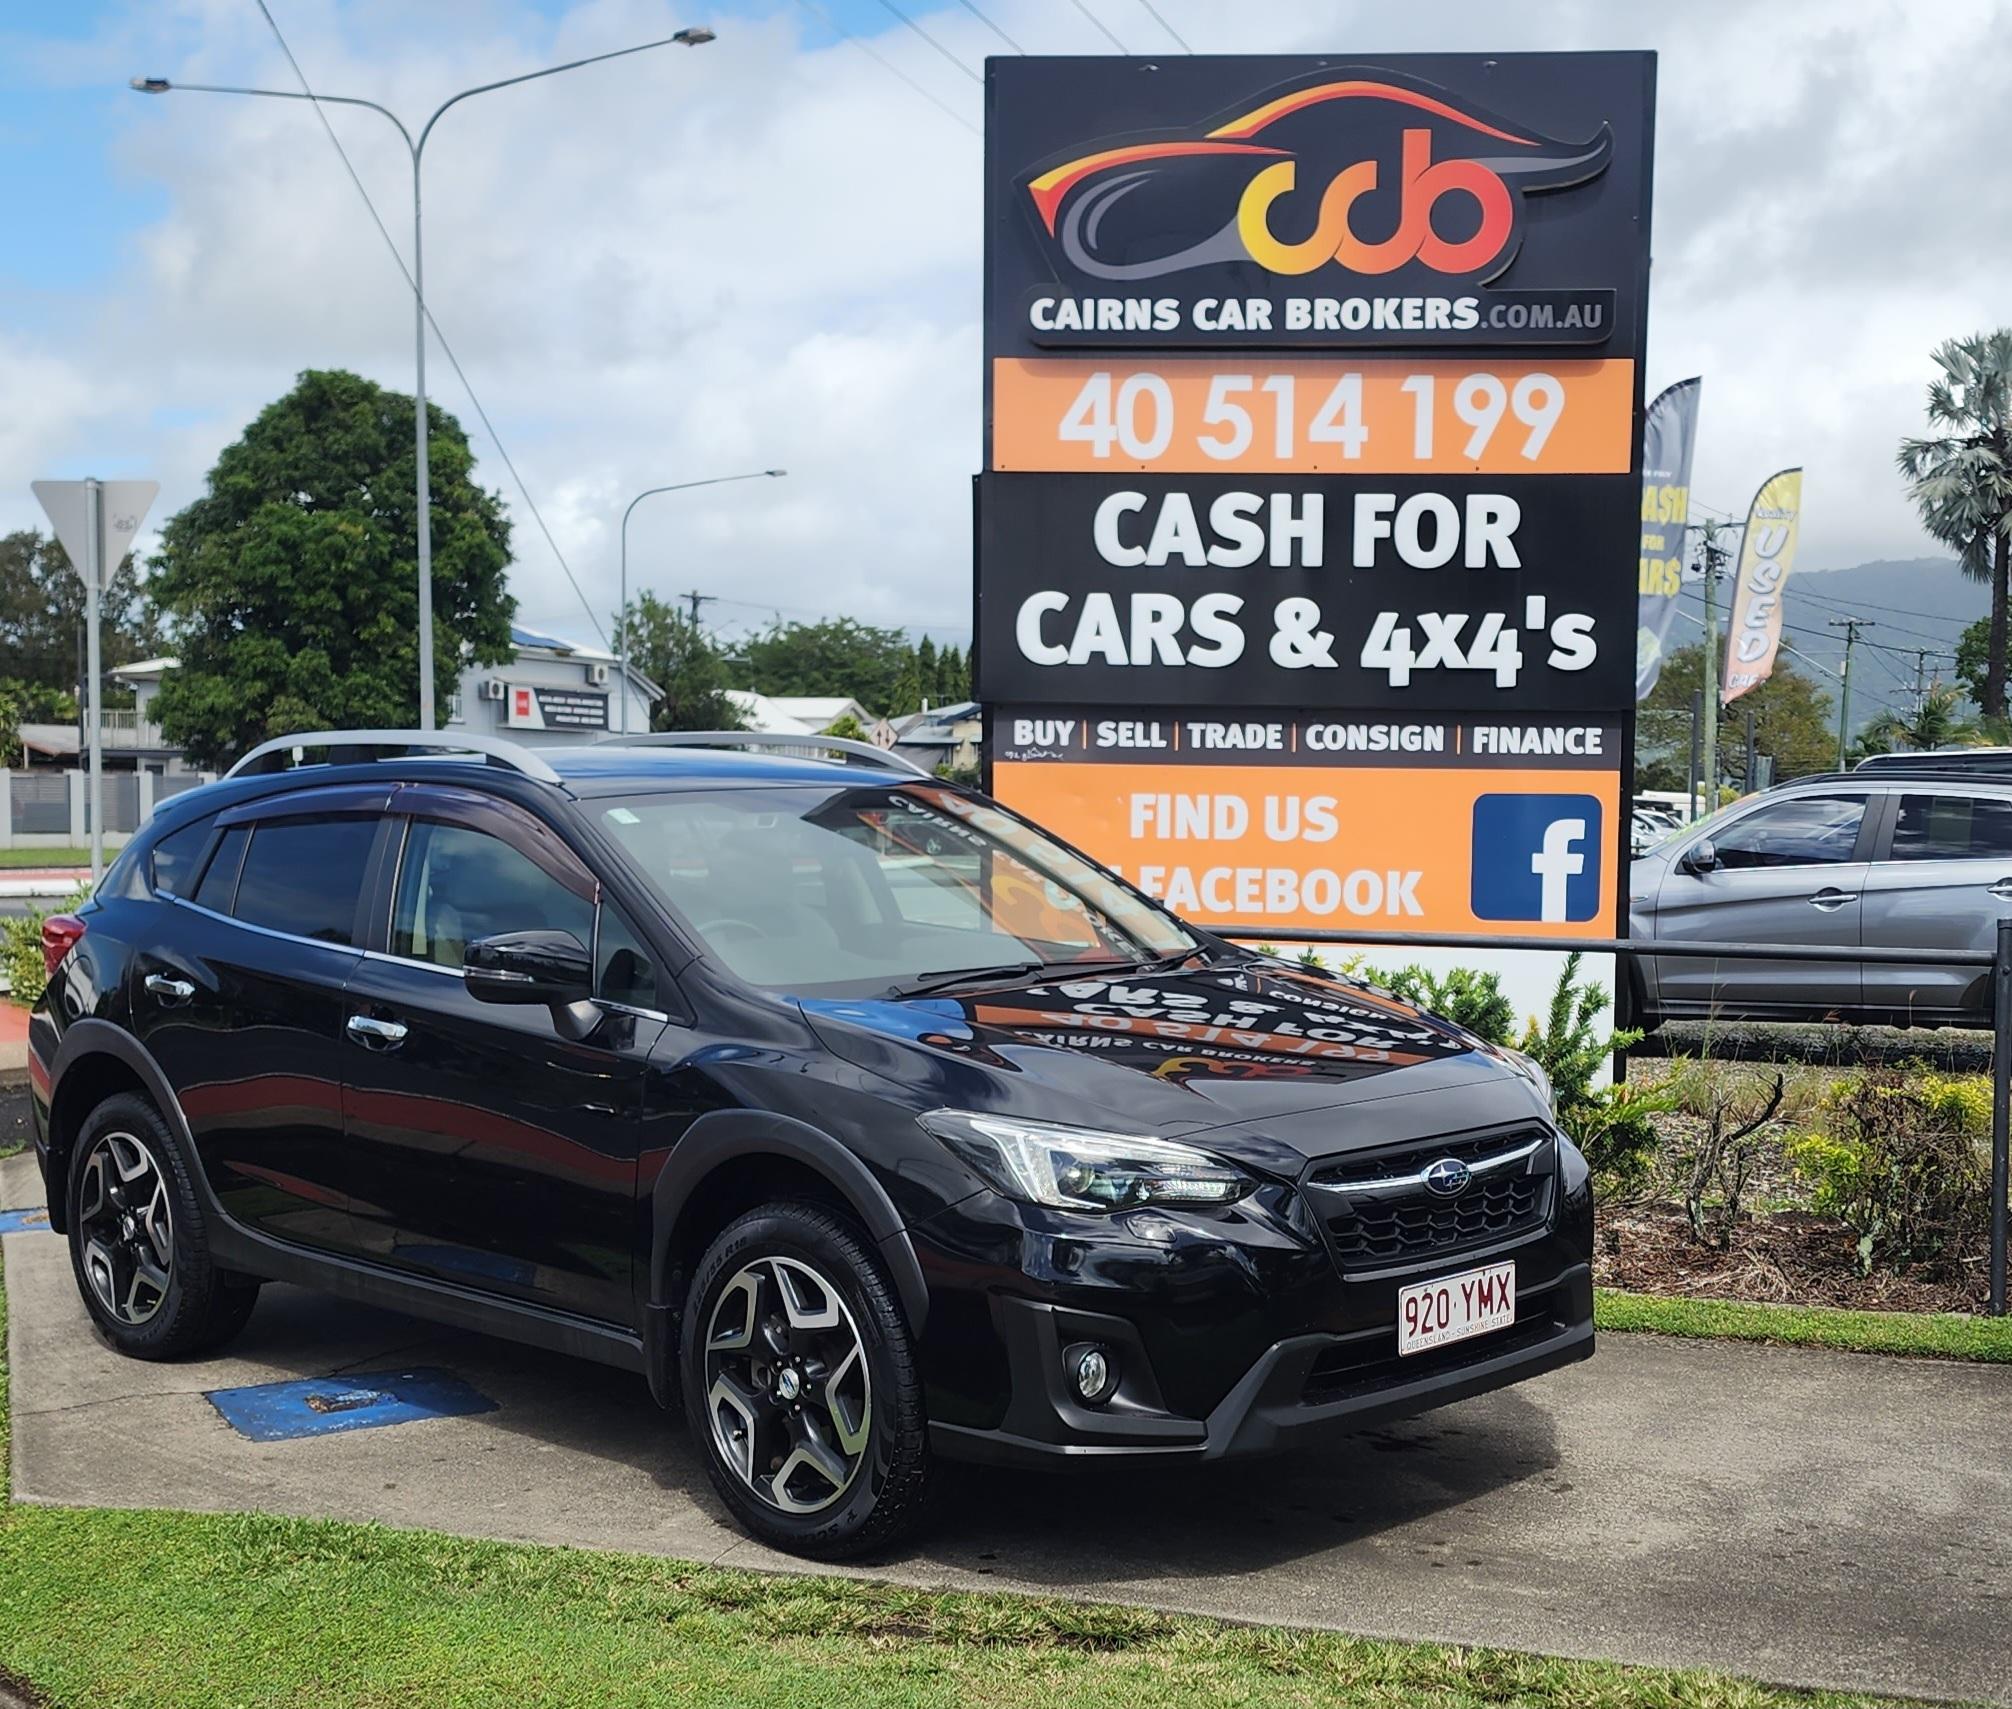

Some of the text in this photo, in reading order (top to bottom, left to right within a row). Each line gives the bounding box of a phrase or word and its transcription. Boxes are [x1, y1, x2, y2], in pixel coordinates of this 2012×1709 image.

[1030, 298, 1180, 331] CAIRNS
[1193, 298, 1272, 331] CAR
[1058, 373, 1565, 461] 40 514 199
[1094, 491, 1522, 569] CASH FOR
[1738, 525, 1789, 663] USED
[1016, 591, 1245, 668] CARS
[1269, 597, 1339, 668] &
[1013, 719, 1603, 755] BUY SELL TRADE CONSIGN FINANCE
[1129, 793, 1340, 842] FIND US
[1139, 866, 1425, 917] FACEBOOK
[1405, 1271, 1511, 1338] 920 YMX
